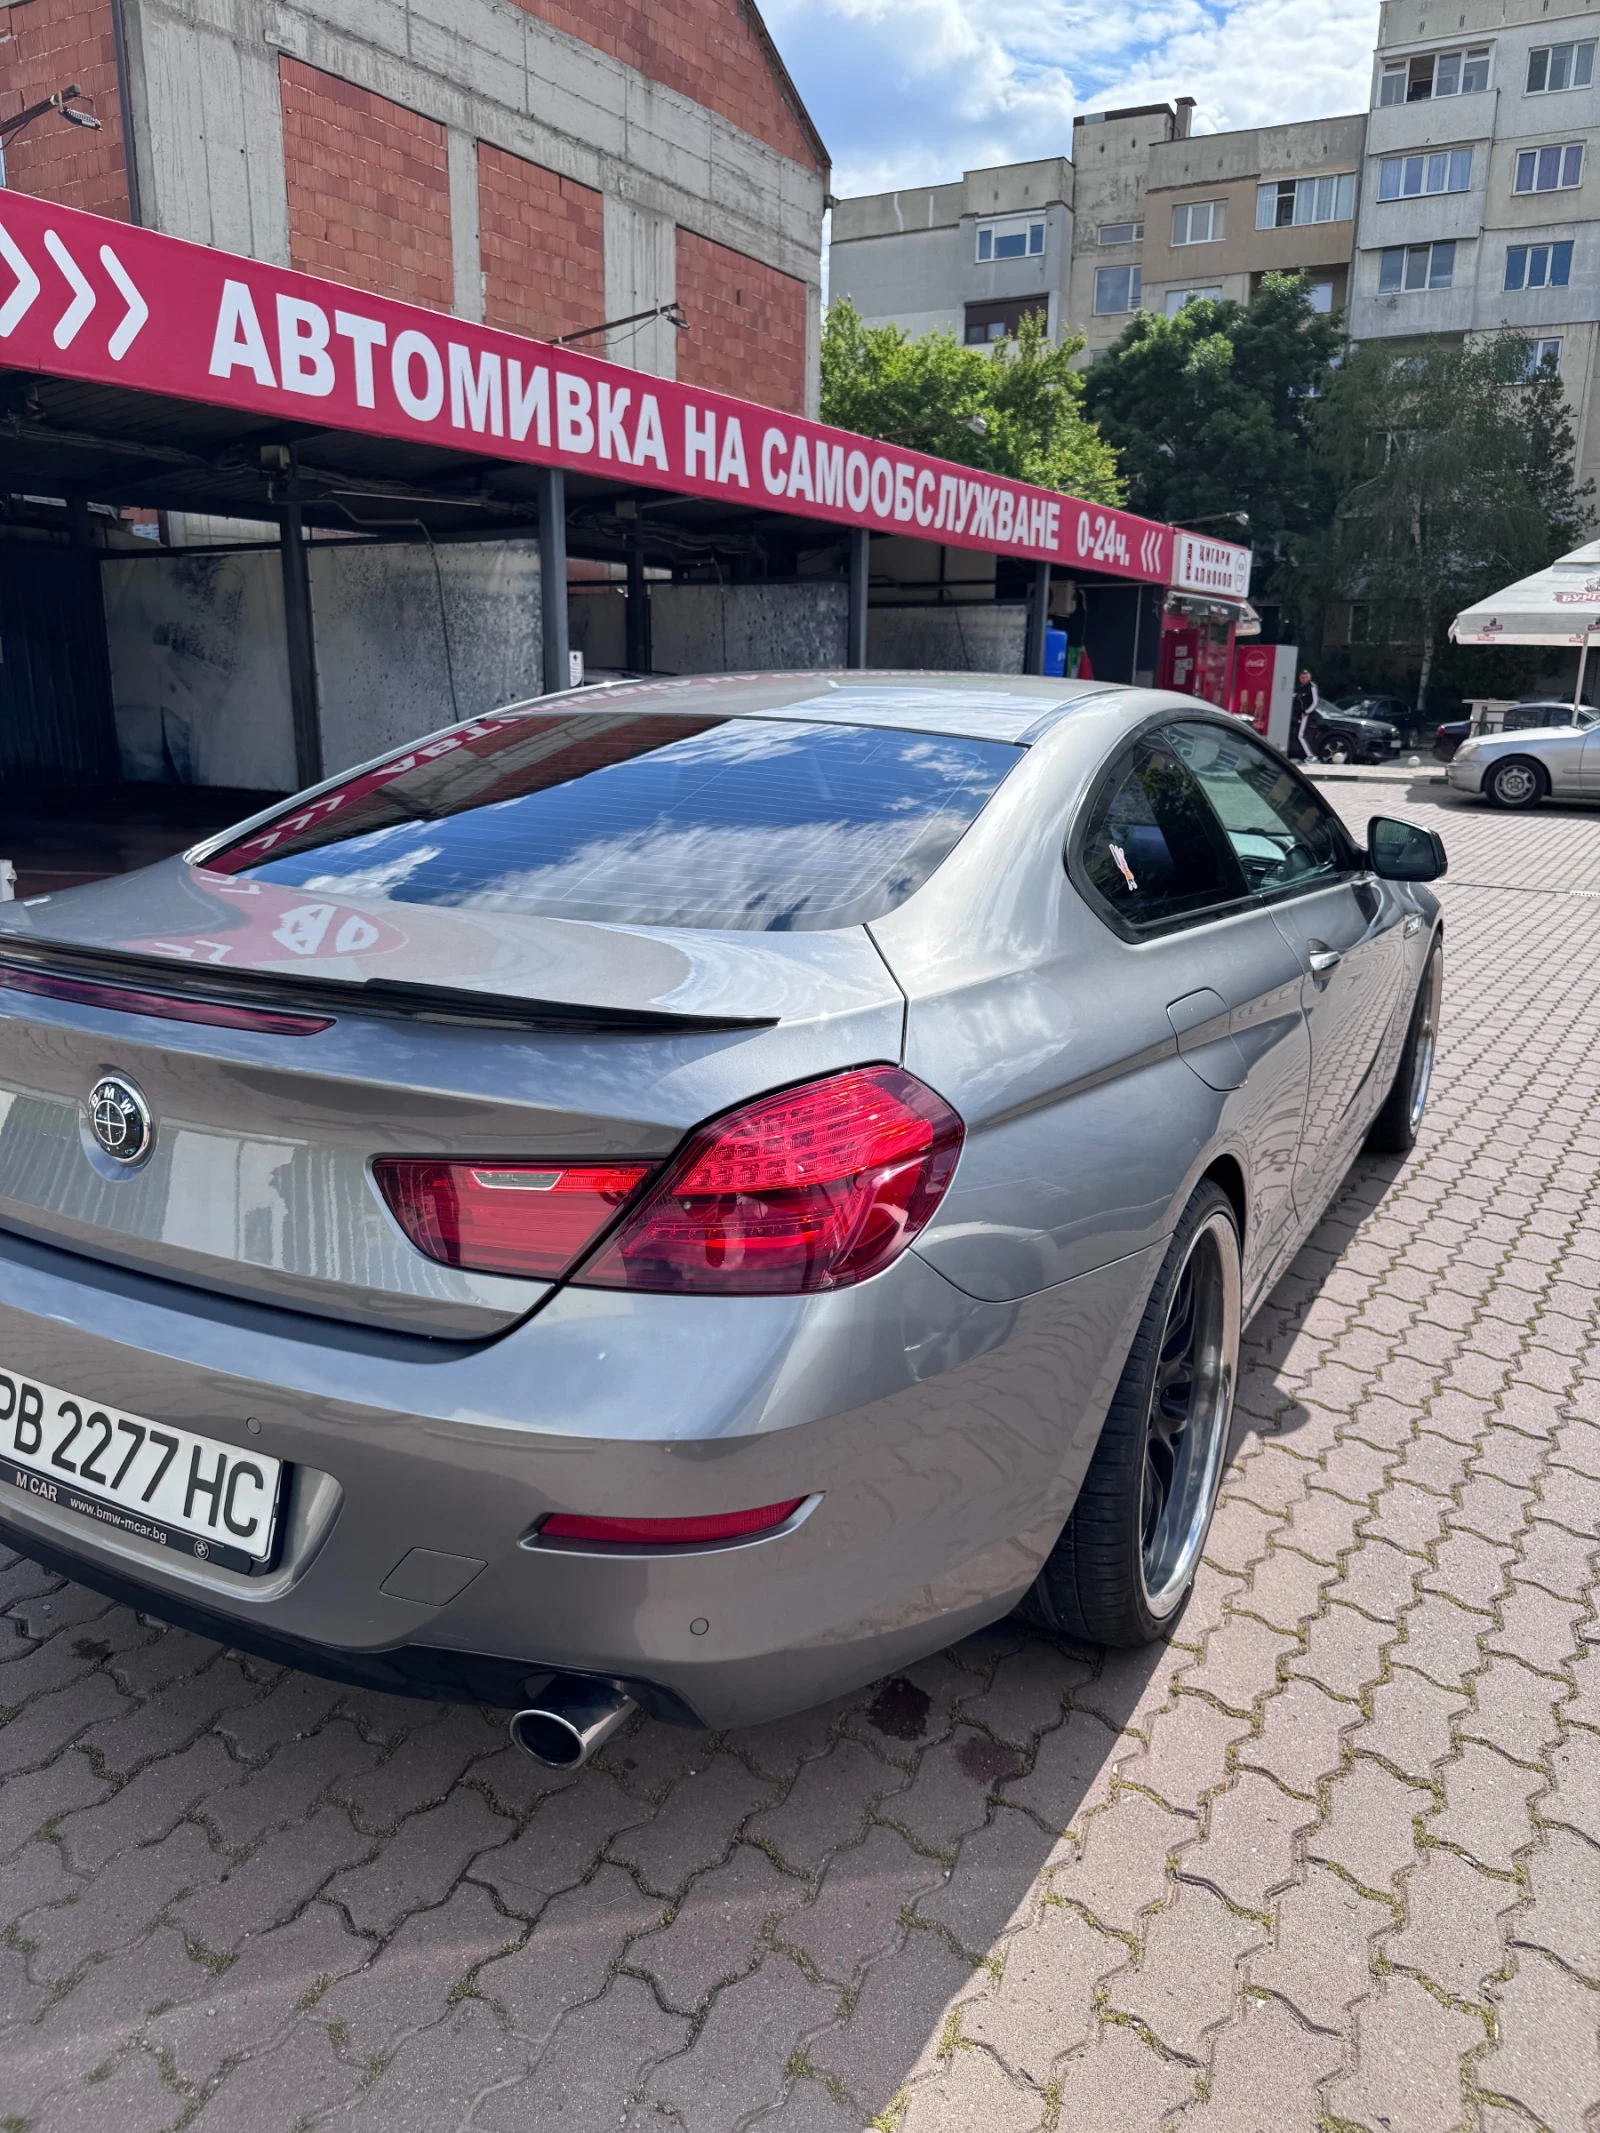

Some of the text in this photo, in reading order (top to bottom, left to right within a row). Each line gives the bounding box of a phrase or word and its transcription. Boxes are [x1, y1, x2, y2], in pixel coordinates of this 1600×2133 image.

[208, 279, 1131, 567] АВТОМИВКА НА САМООБСЛУЖВАНЕ 0-24ч.
[90, 1086, 136, 1115] BMW
[16, 1471, 168, 1544] M CAR www.bmw-mcar.bg
[51, 1400, 179, 1503] 2277
[183, 1444, 264, 1538] HC
